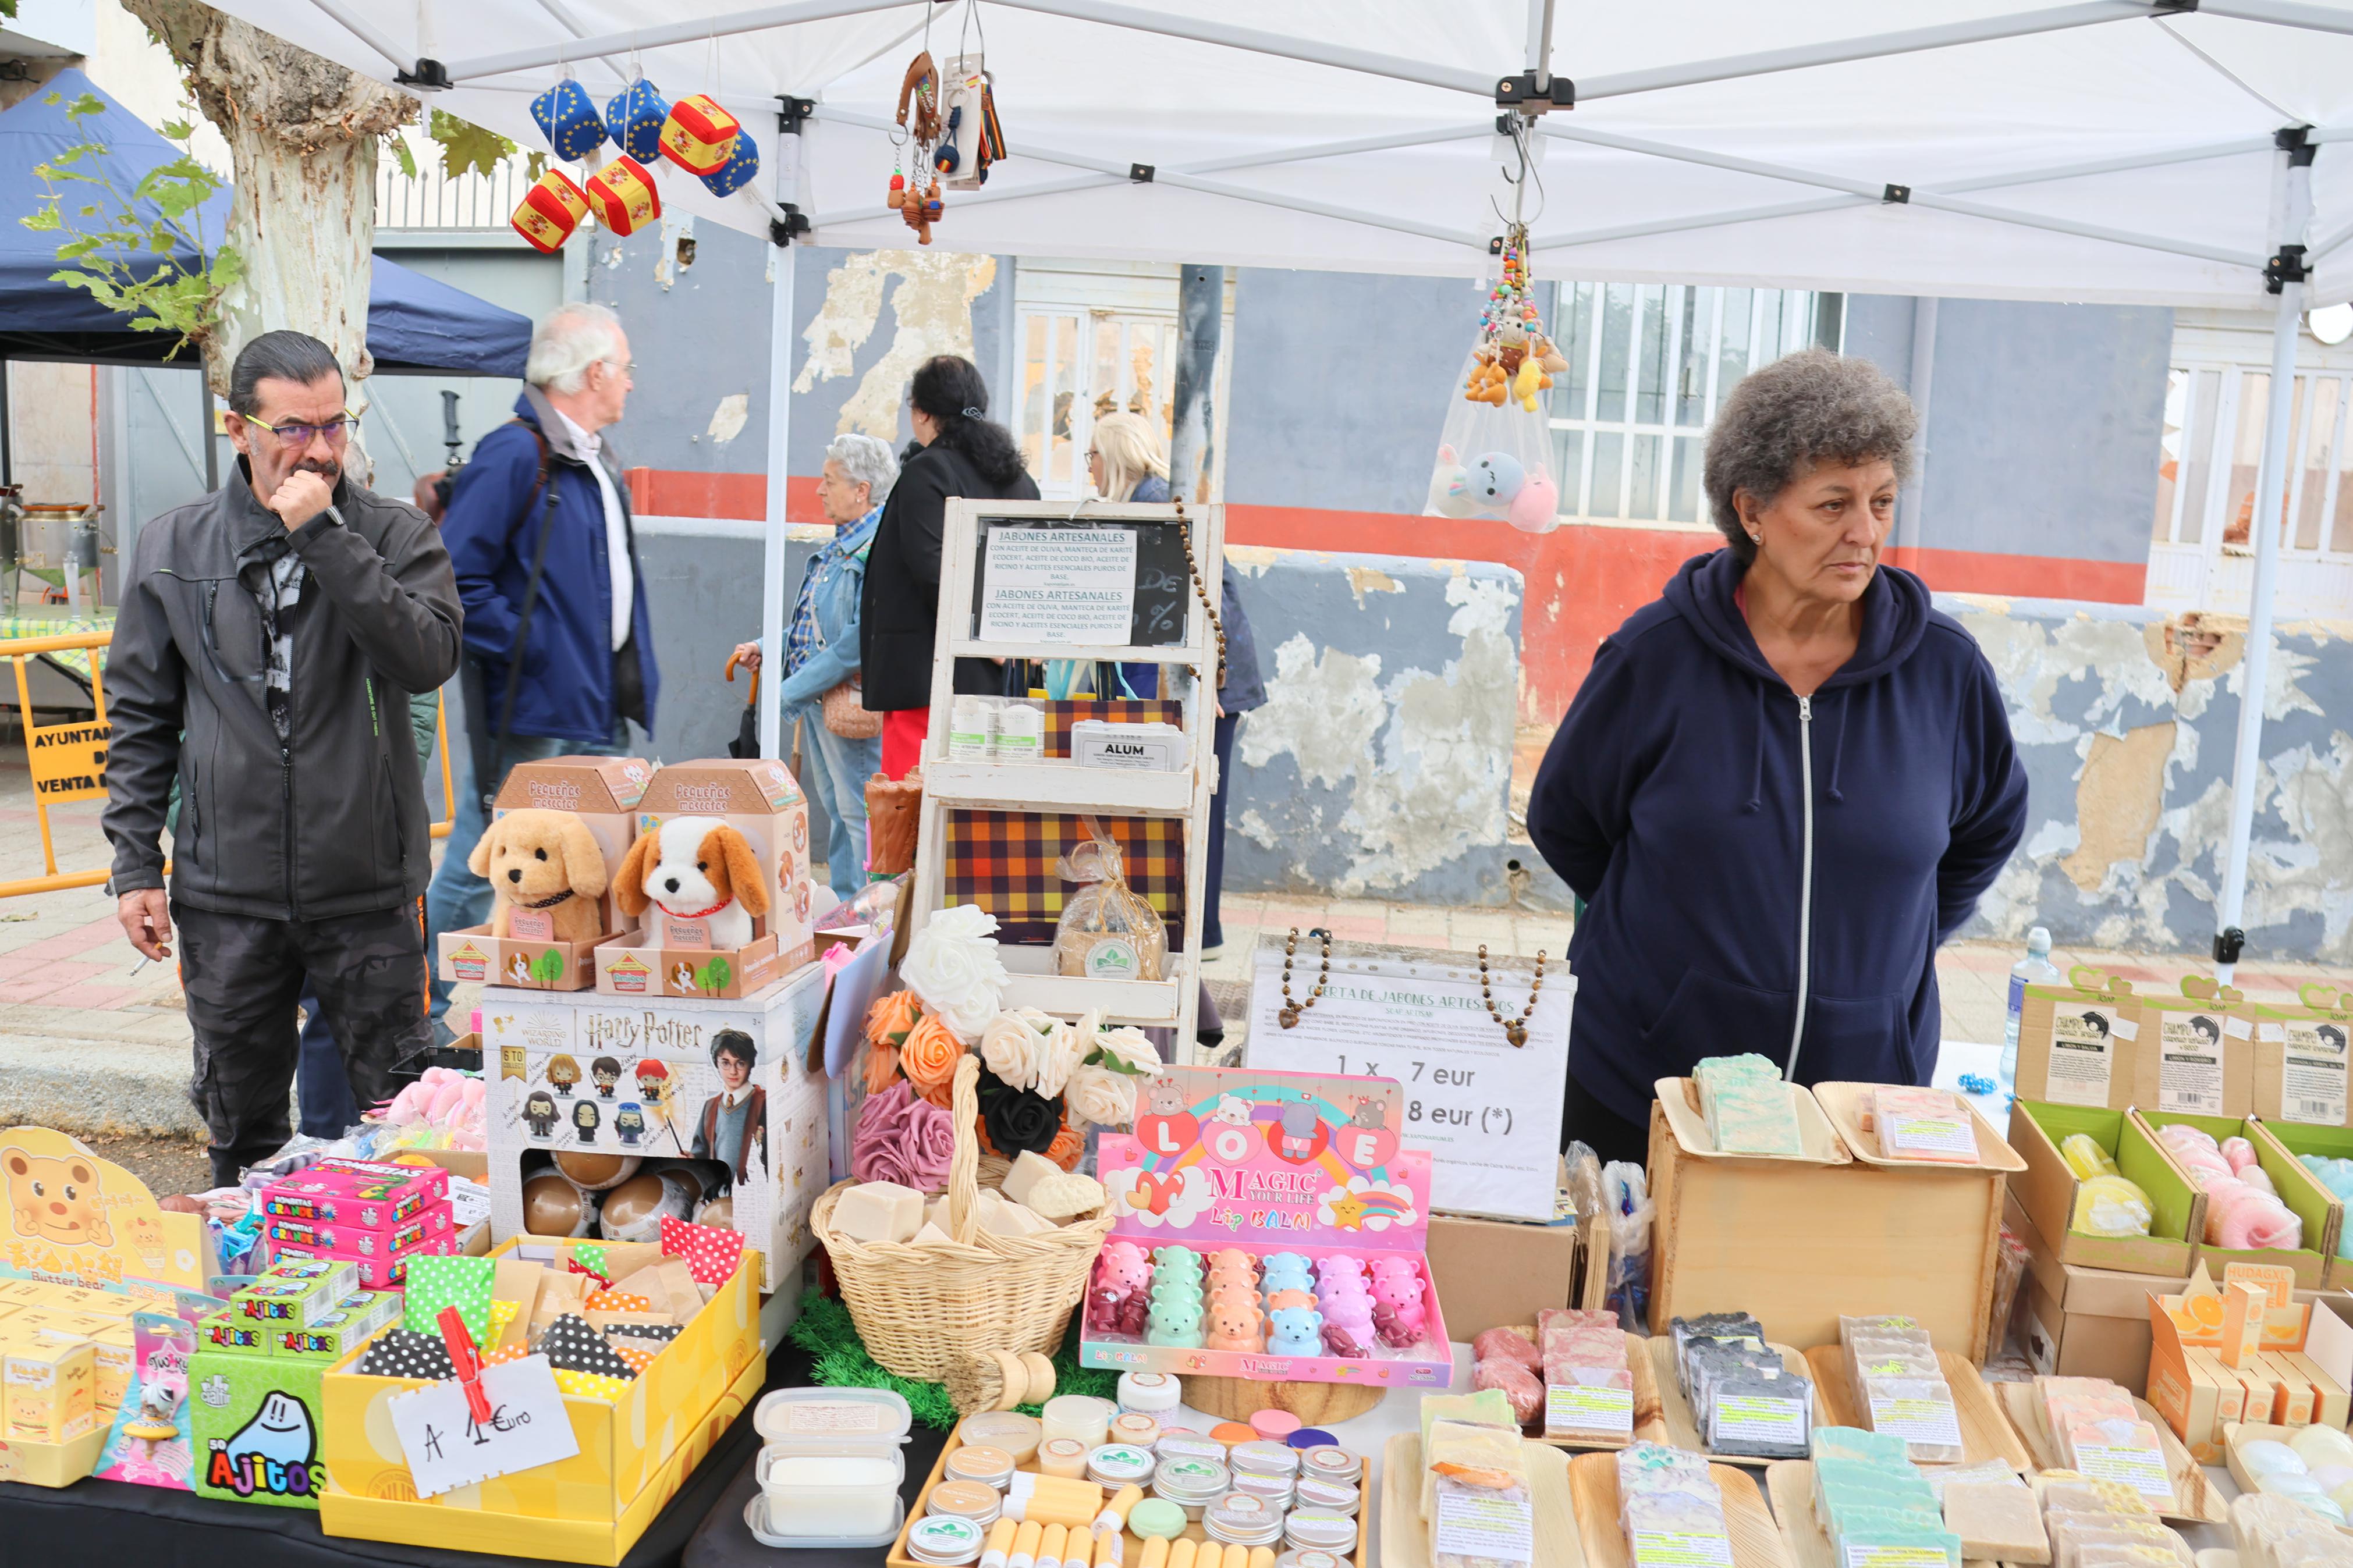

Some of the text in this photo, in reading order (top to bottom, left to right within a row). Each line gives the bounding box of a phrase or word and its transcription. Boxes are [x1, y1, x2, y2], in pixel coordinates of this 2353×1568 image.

[999, 531, 1125, 543] JABONES ARTESANALES
[995, 589, 1123, 601] JABONES ARTESANALES
[94, 750, 109, 765] D
[1105, 743, 1145, 756] ALUM
[37, 775, 96, 793] VENTA
[529, 780, 581, 798] Pequeñas
[675, 783, 730, 800] Pequeñas
[532, 798, 578, 810] mascotas
[679, 800, 727, 812] mascotas
[614, 973, 645, 984] Amigos
[1308, 984, 1357, 999] OERTA
[1360, 989, 1374, 1000] DE
[1379, 991, 1434, 1005] JABONES
[521, 1029, 567, 1039] WIZARDING
[527, 1037, 562, 1047] WORLD
[584, 1011, 702, 1056] Harry Potter
[503, 1051, 523, 1061] 6 TO
[503, 1061, 524, 1069] COLLECT
[1338, 1055, 1475, 1087] 1 x 7 eur
[1408, 1100, 1422, 1122] 8
[1431, 1106, 1474, 1126] eur
[1208, 1168, 1316, 1200] MAGIC
[1249, 1190, 1315, 1205] YOUR LIFE
[267, 1201, 321, 1220] GRANDES
[392, 1195, 425, 1222] GRANDES
[1251, 1209, 1311, 1231] BALM
[270, 1226, 321, 1246] GRANDES
[389, 1228, 426, 1252] GRANDES
[31, 1271, 106, 1291] Butter bear
[237, 1299, 296, 1321] 50 Ajitos
[204, 1325, 261, 1347] 50 Ajitos
[276, 1332, 335, 1353] 50 Ajitos
[208, 1438, 227, 1450] 50
[424, 1423, 444, 1462] A
[205, 1451, 326, 1499] Ajitos
